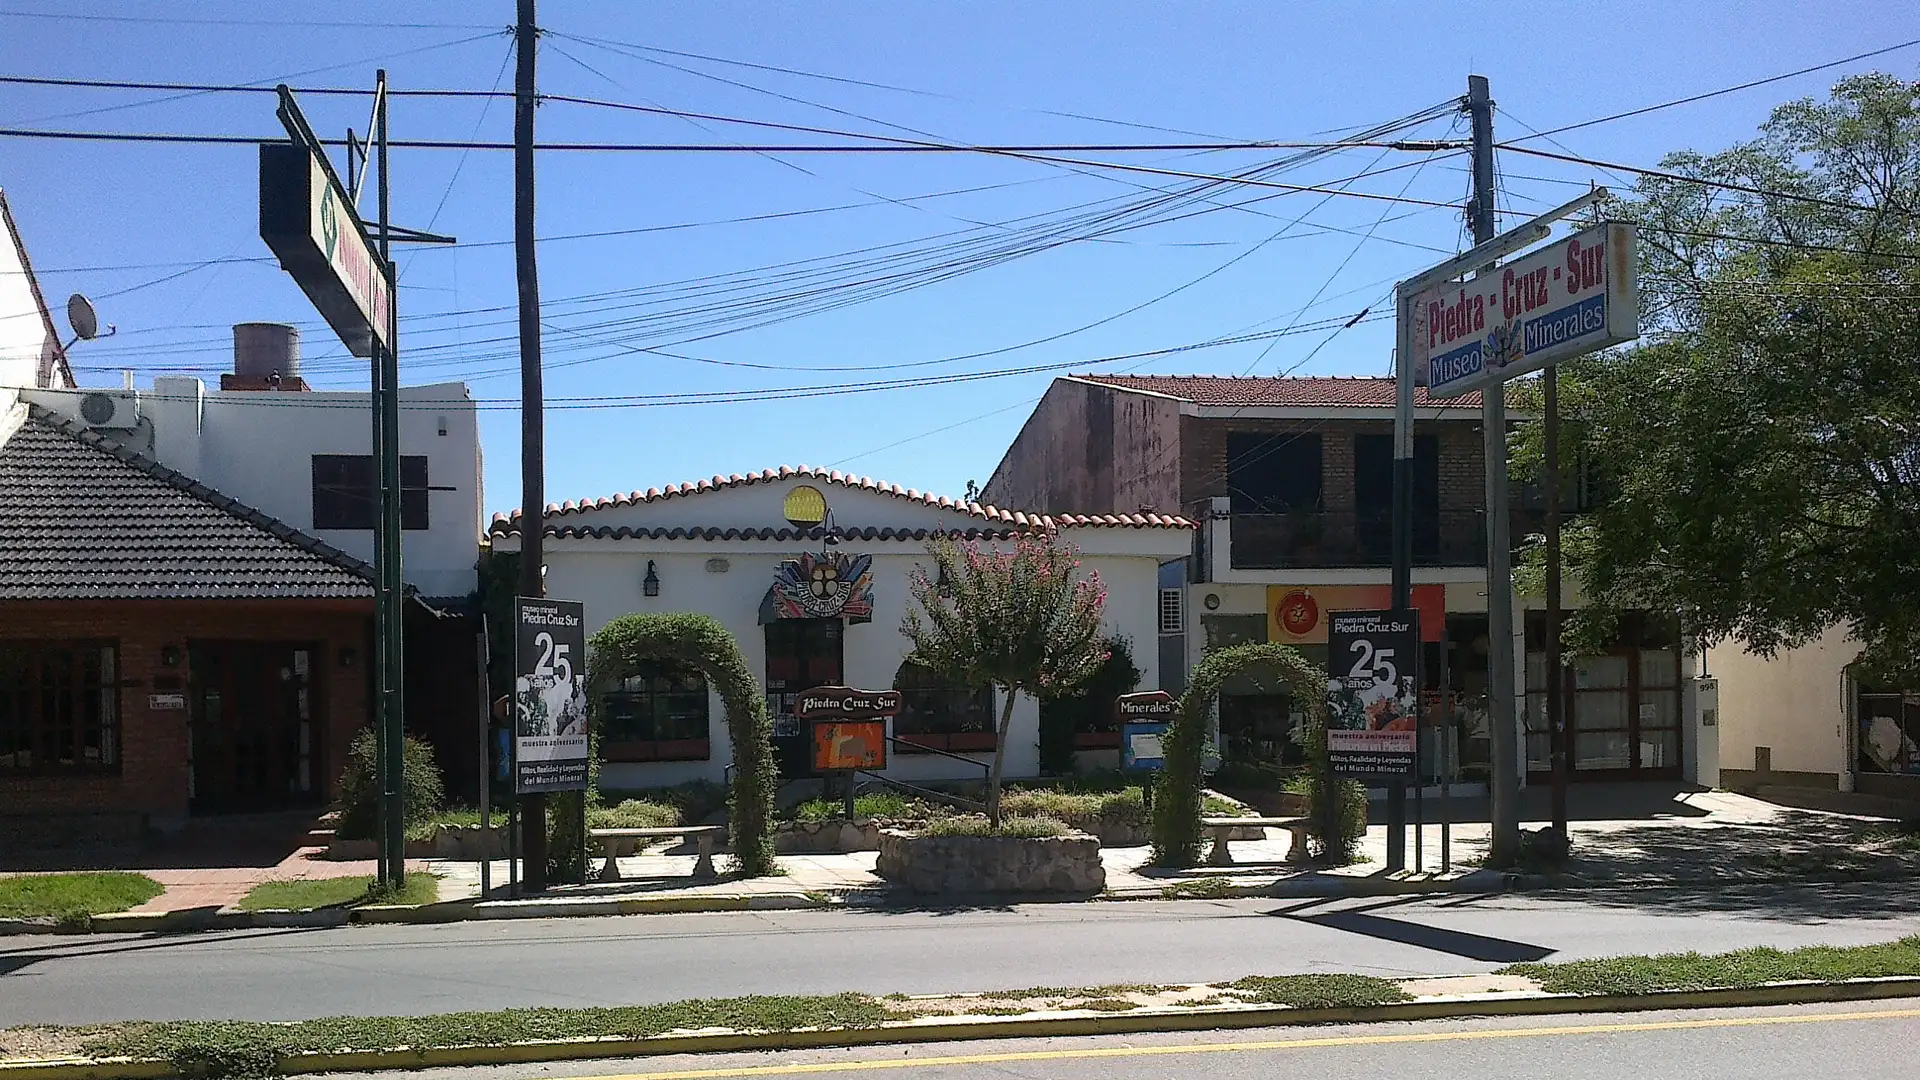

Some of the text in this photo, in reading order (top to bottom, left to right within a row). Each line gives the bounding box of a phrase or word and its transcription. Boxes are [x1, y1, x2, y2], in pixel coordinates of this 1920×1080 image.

[1429, 289, 1484, 348] Piedra
[1502, 267, 1548, 319] Cruz
[1567, 239, 1604, 294] Sur
[1525, 304, 1603, 350] Minerales
[1432, 351, 1478, 386] Museo
[522, 612, 578, 626] Piedra Cruz Sur
[1334, 621, 1409, 633] Piedra Cruz Sur
[535, 632, 572, 683] 25
[1349, 640, 1397, 685] 25
[1348, 678, 1372, 688] años
[802, 697, 896, 714] Piedra Cruz Sur
[1121, 701, 1170, 713] Minerales
[522, 738, 584, 748] muestra aniversario
[1382, 756, 1412, 764] Leyendas
[524, 774, 582, 785] del Mundo Mineral
